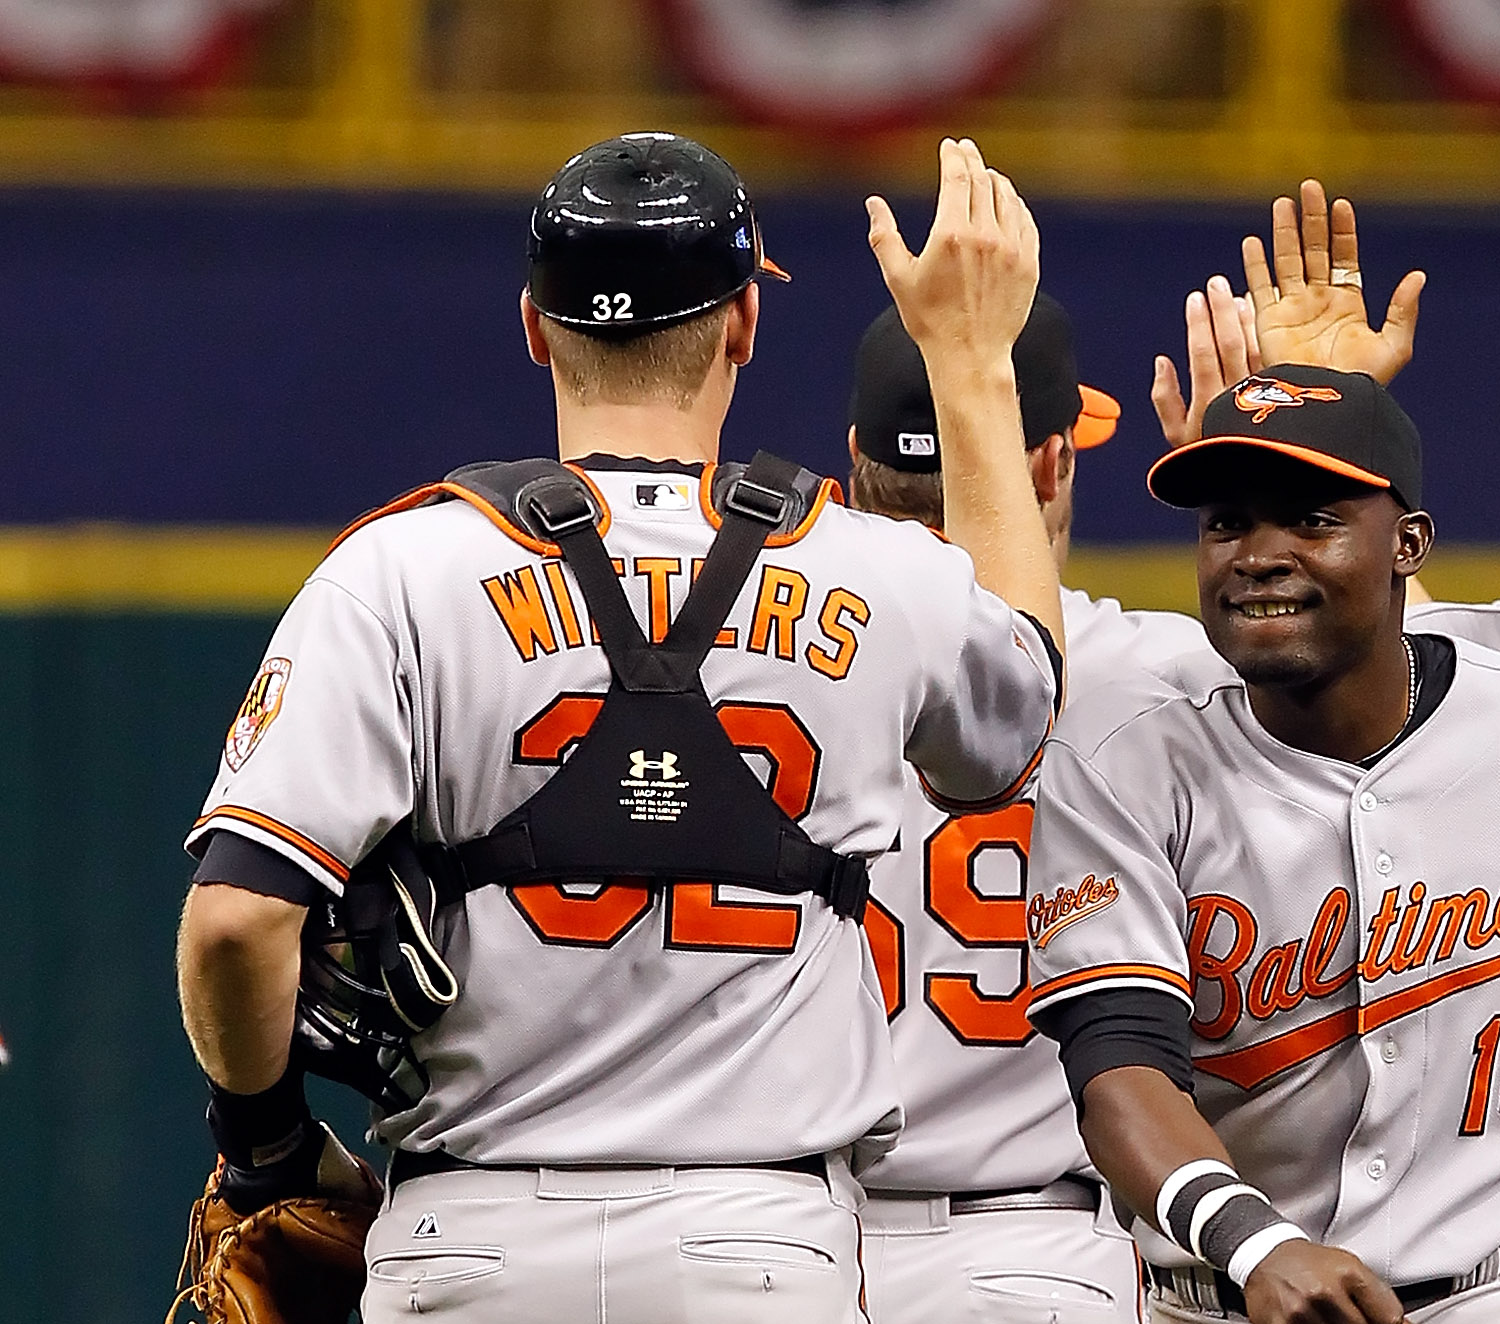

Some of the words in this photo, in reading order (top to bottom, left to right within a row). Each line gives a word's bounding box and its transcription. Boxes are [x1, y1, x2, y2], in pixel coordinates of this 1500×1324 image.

[592, 293, 633, 320] 32
[481, 556, 871, 682] WITRS
[864, 799, 1036, 1047] 9
[1027, 874, 1120, 940] Orioles
